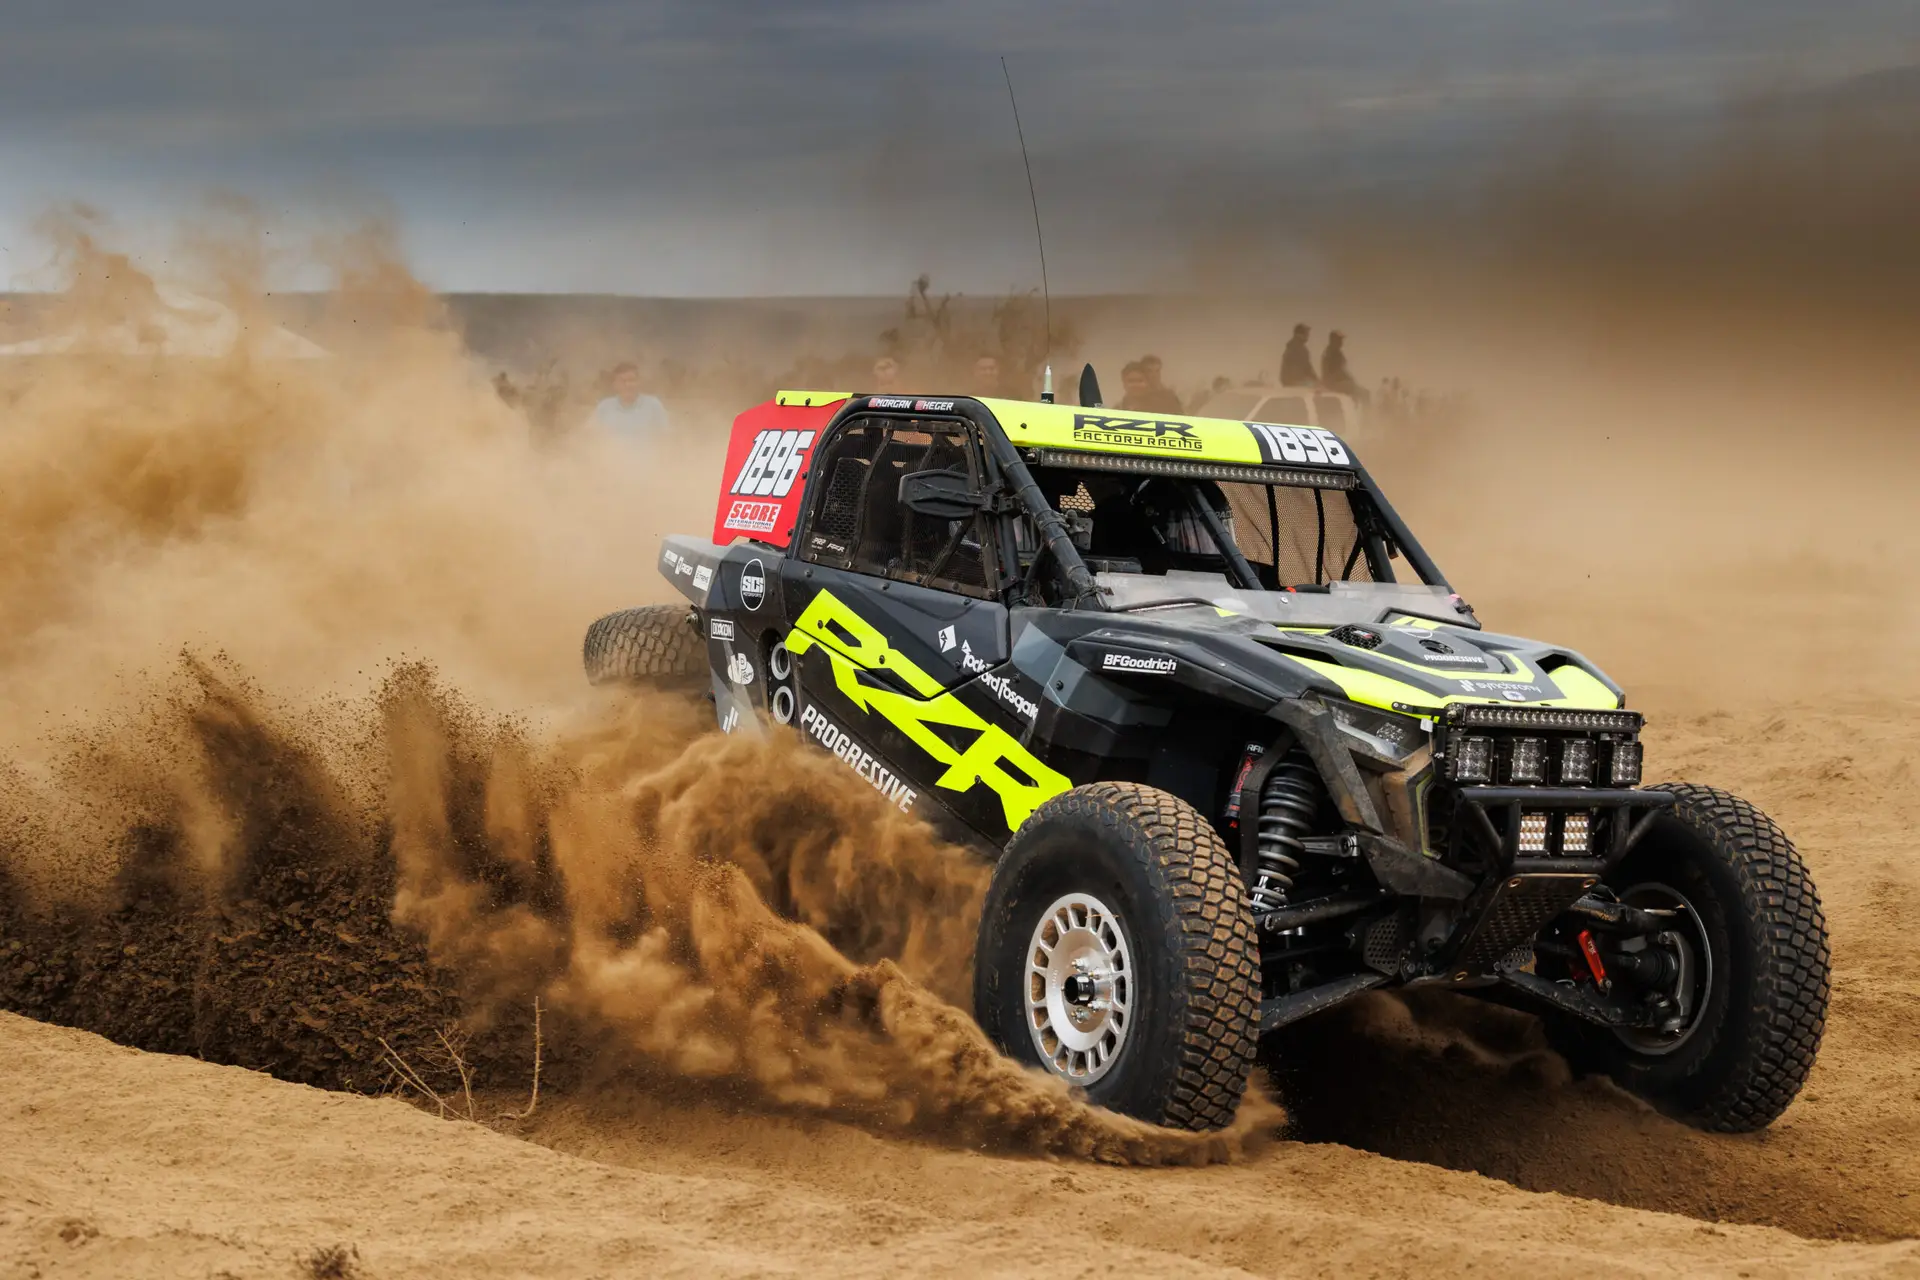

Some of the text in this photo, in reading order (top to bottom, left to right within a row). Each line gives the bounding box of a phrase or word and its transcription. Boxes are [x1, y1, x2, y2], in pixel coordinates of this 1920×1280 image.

[876, 398, 954, 411] MORGAN HEGER
[1074, 414, 1199, 438] RZR
[1074, 431, 1203, 449] FACTORY RACING
[1252, 424, 1350, 465] 1896
[729, 429, 816, 498] 1896
[730, 503, 779, 522] SCORE
[1103, 654, 1177, 671] BFGoodrich
[1423, 654, 1484, 663] PROGRESSIVE
[785, 588, 1073, 833] RZR
[800, 703, 917, 814] PROGRESSIVE
